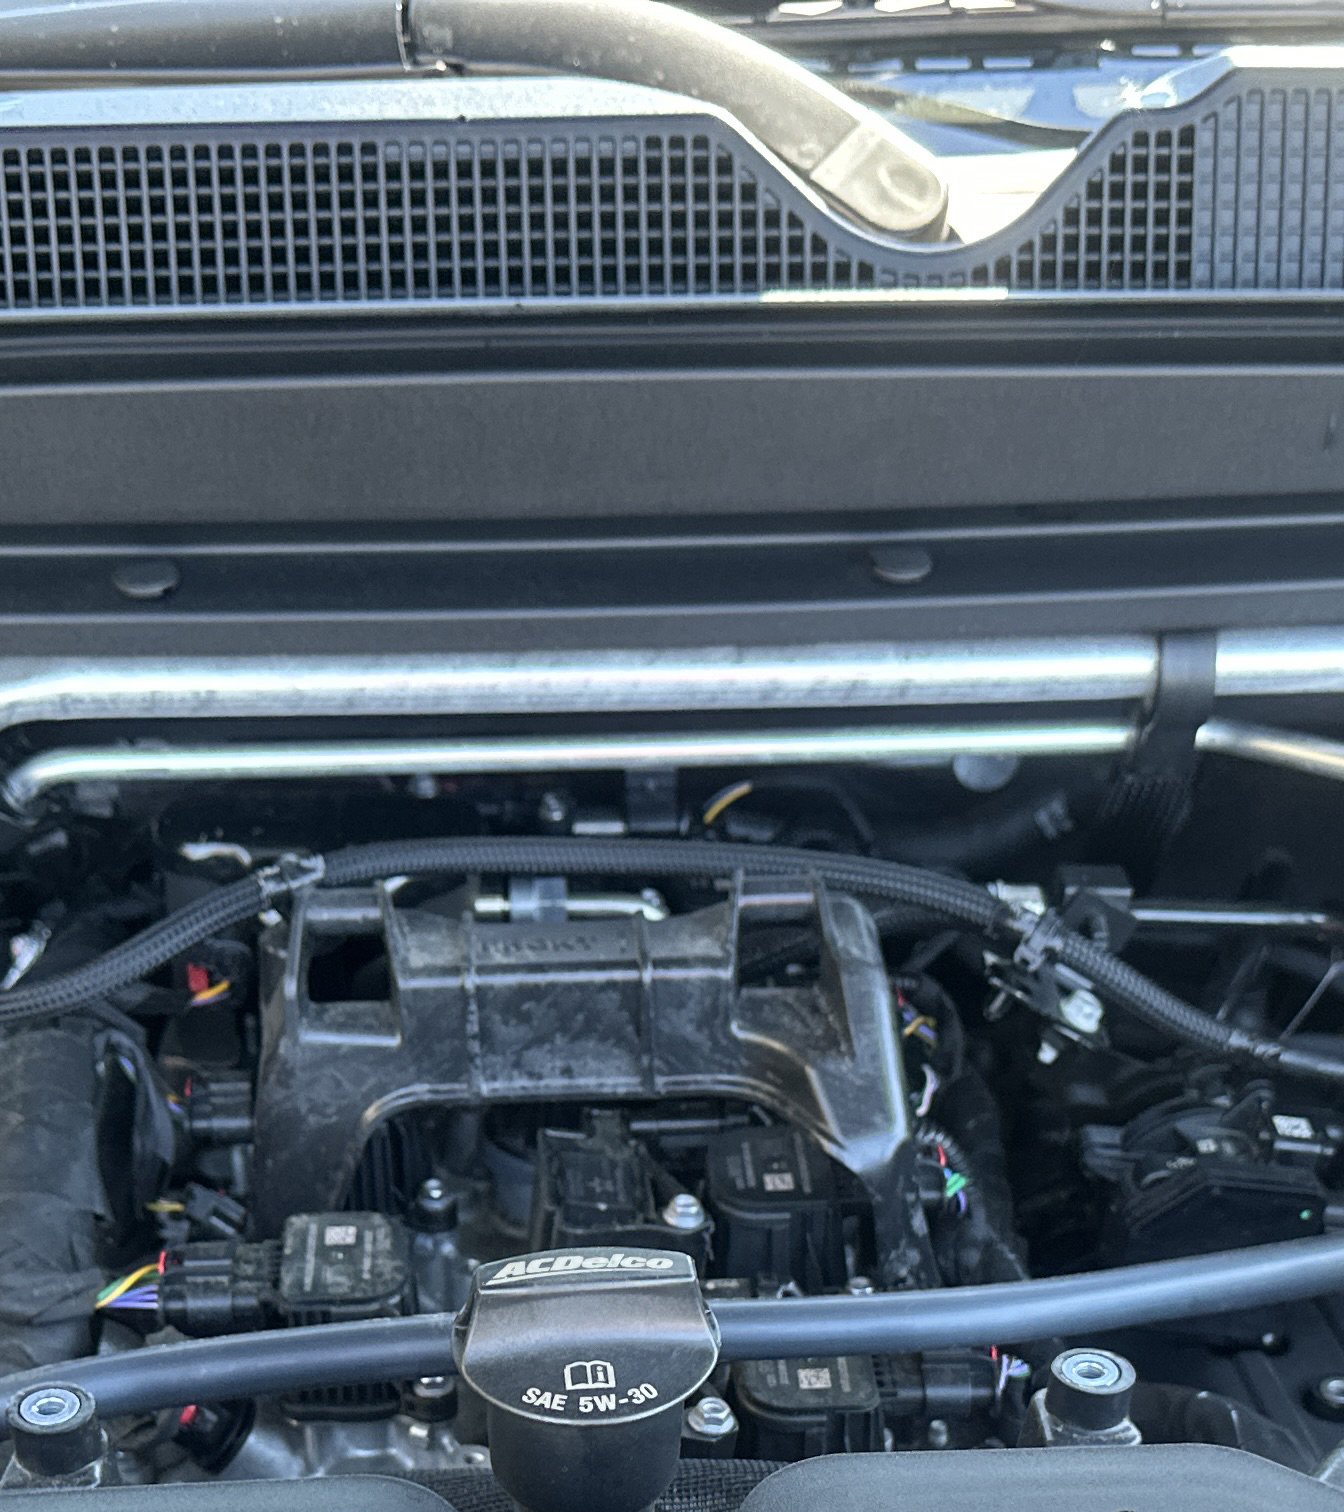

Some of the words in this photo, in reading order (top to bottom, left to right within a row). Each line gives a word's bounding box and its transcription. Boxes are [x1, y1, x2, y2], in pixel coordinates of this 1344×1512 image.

[489, 1253, 674, 1281] ACDelco
[521, 1386, 568, 1411] SAE
[579, 1383, 658, 1413] 5W-30
